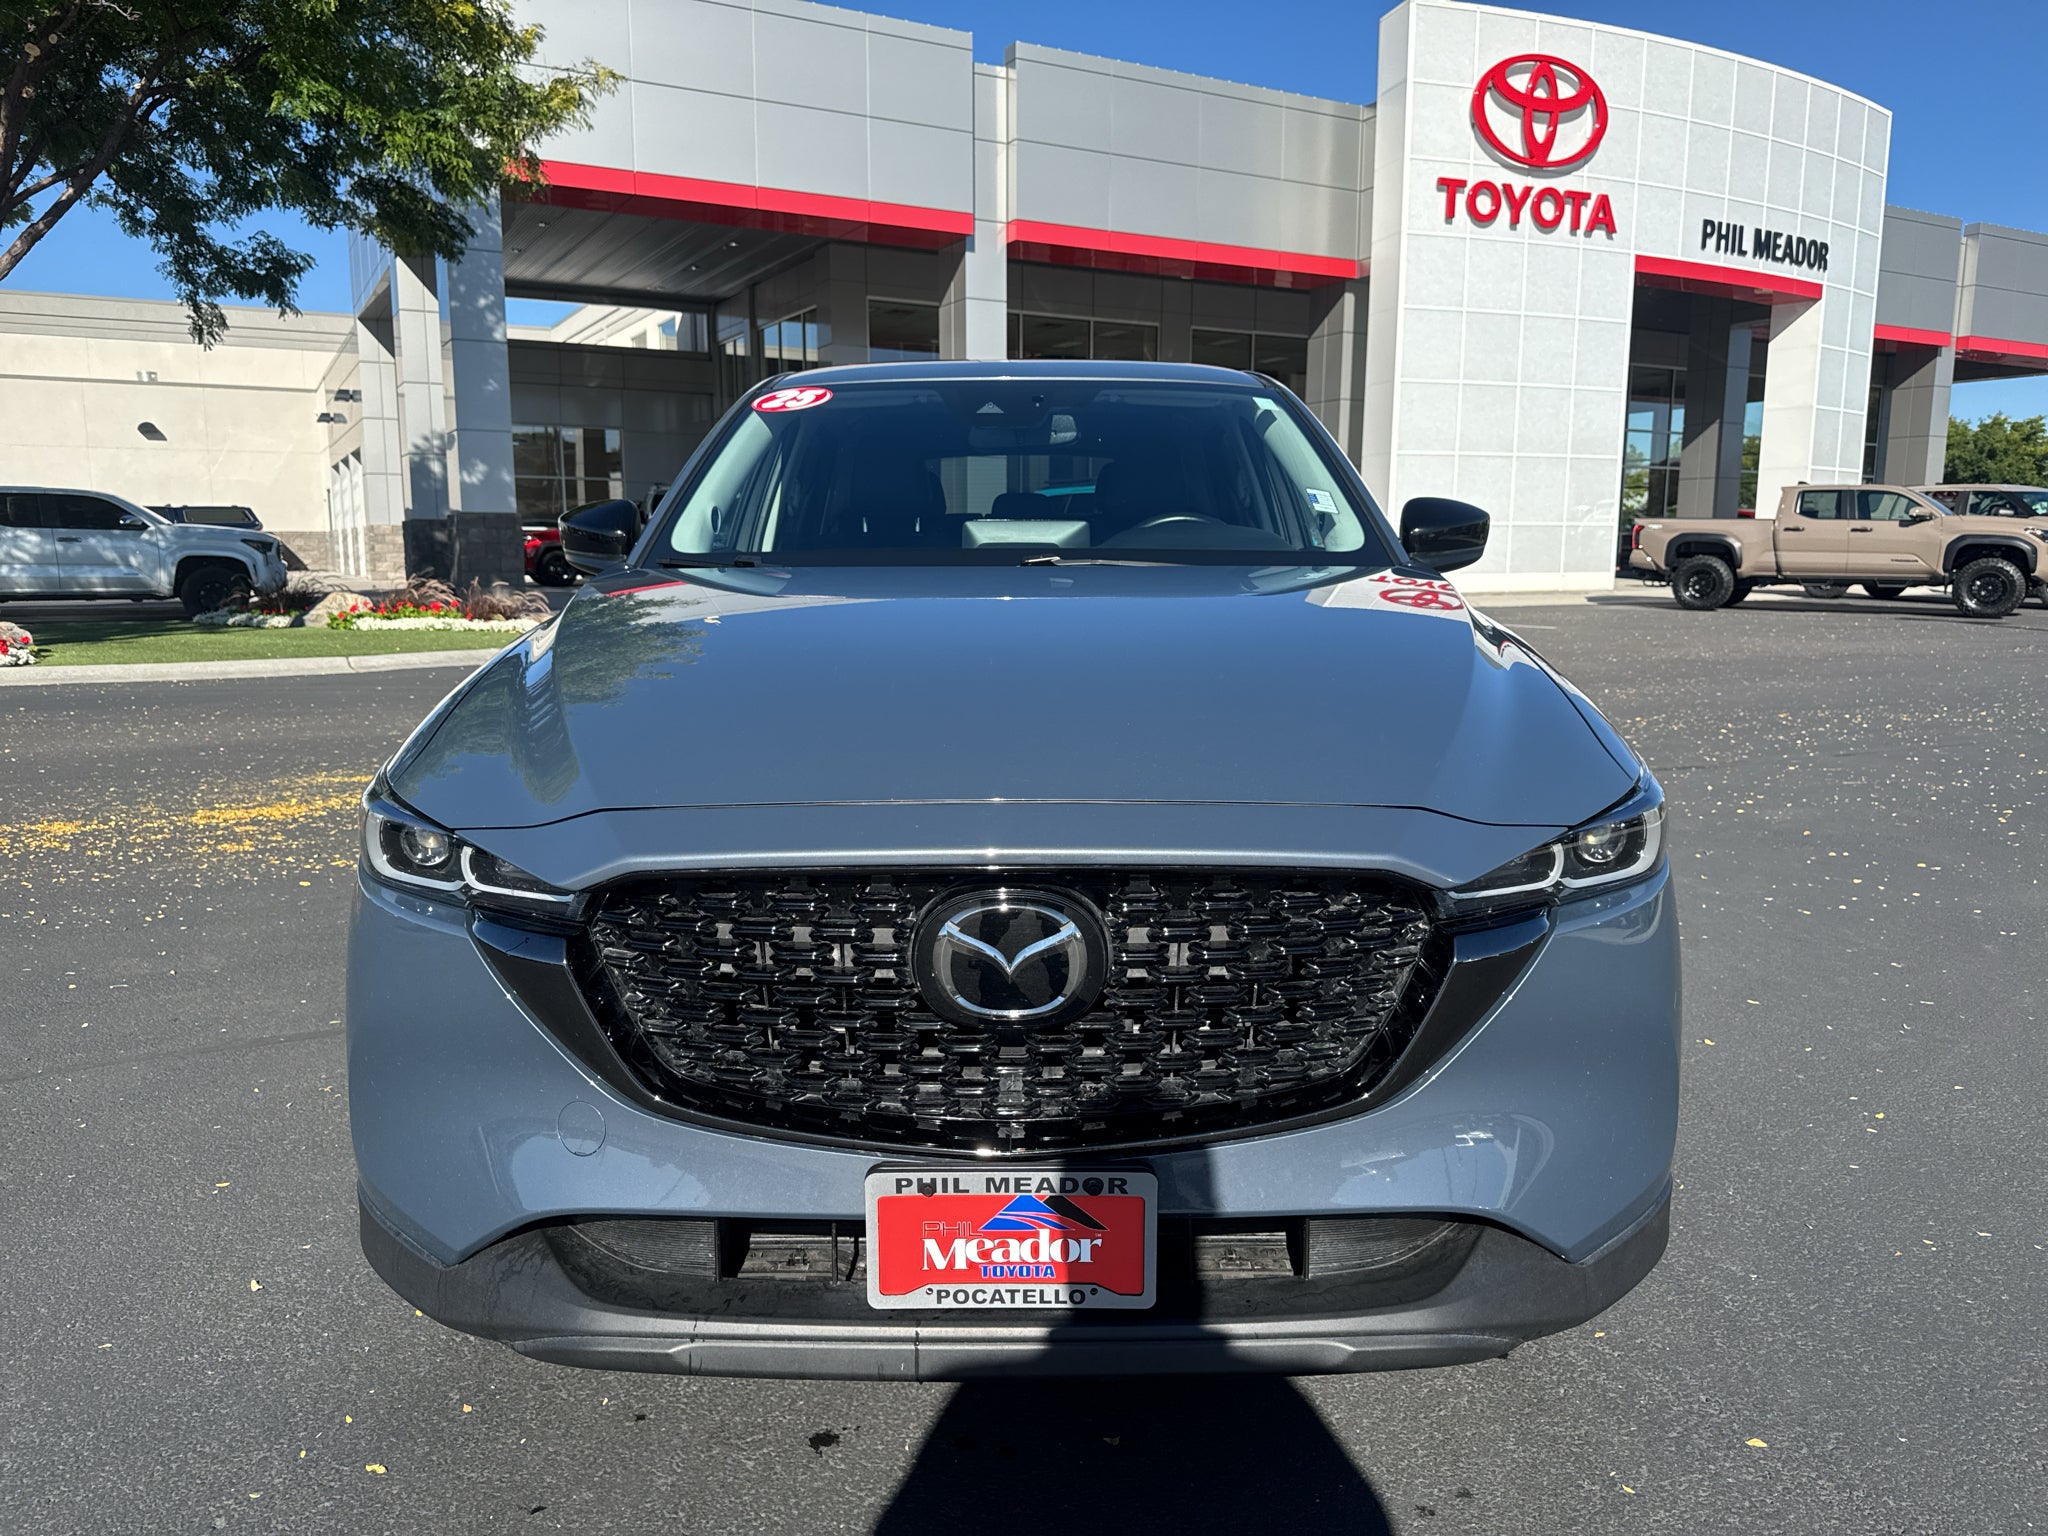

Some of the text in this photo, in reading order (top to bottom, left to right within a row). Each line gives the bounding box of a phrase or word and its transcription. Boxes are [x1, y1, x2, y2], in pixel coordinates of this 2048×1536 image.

[1436, 177, 1617, 235] TOYOTA
[1701, 218, 1830, 271] PHIL MEADOR
[761, 389, 827, 408] 25
[895, 1178, 970, 1194] PHIL
[922, 1221, 984, 1237] PHIL
[921, 1228, 1103, 1270] Meador
[979, 1264, 1056, 1279] TOYOTA
[936, 1288, 1087, 1305] POCATELLO
